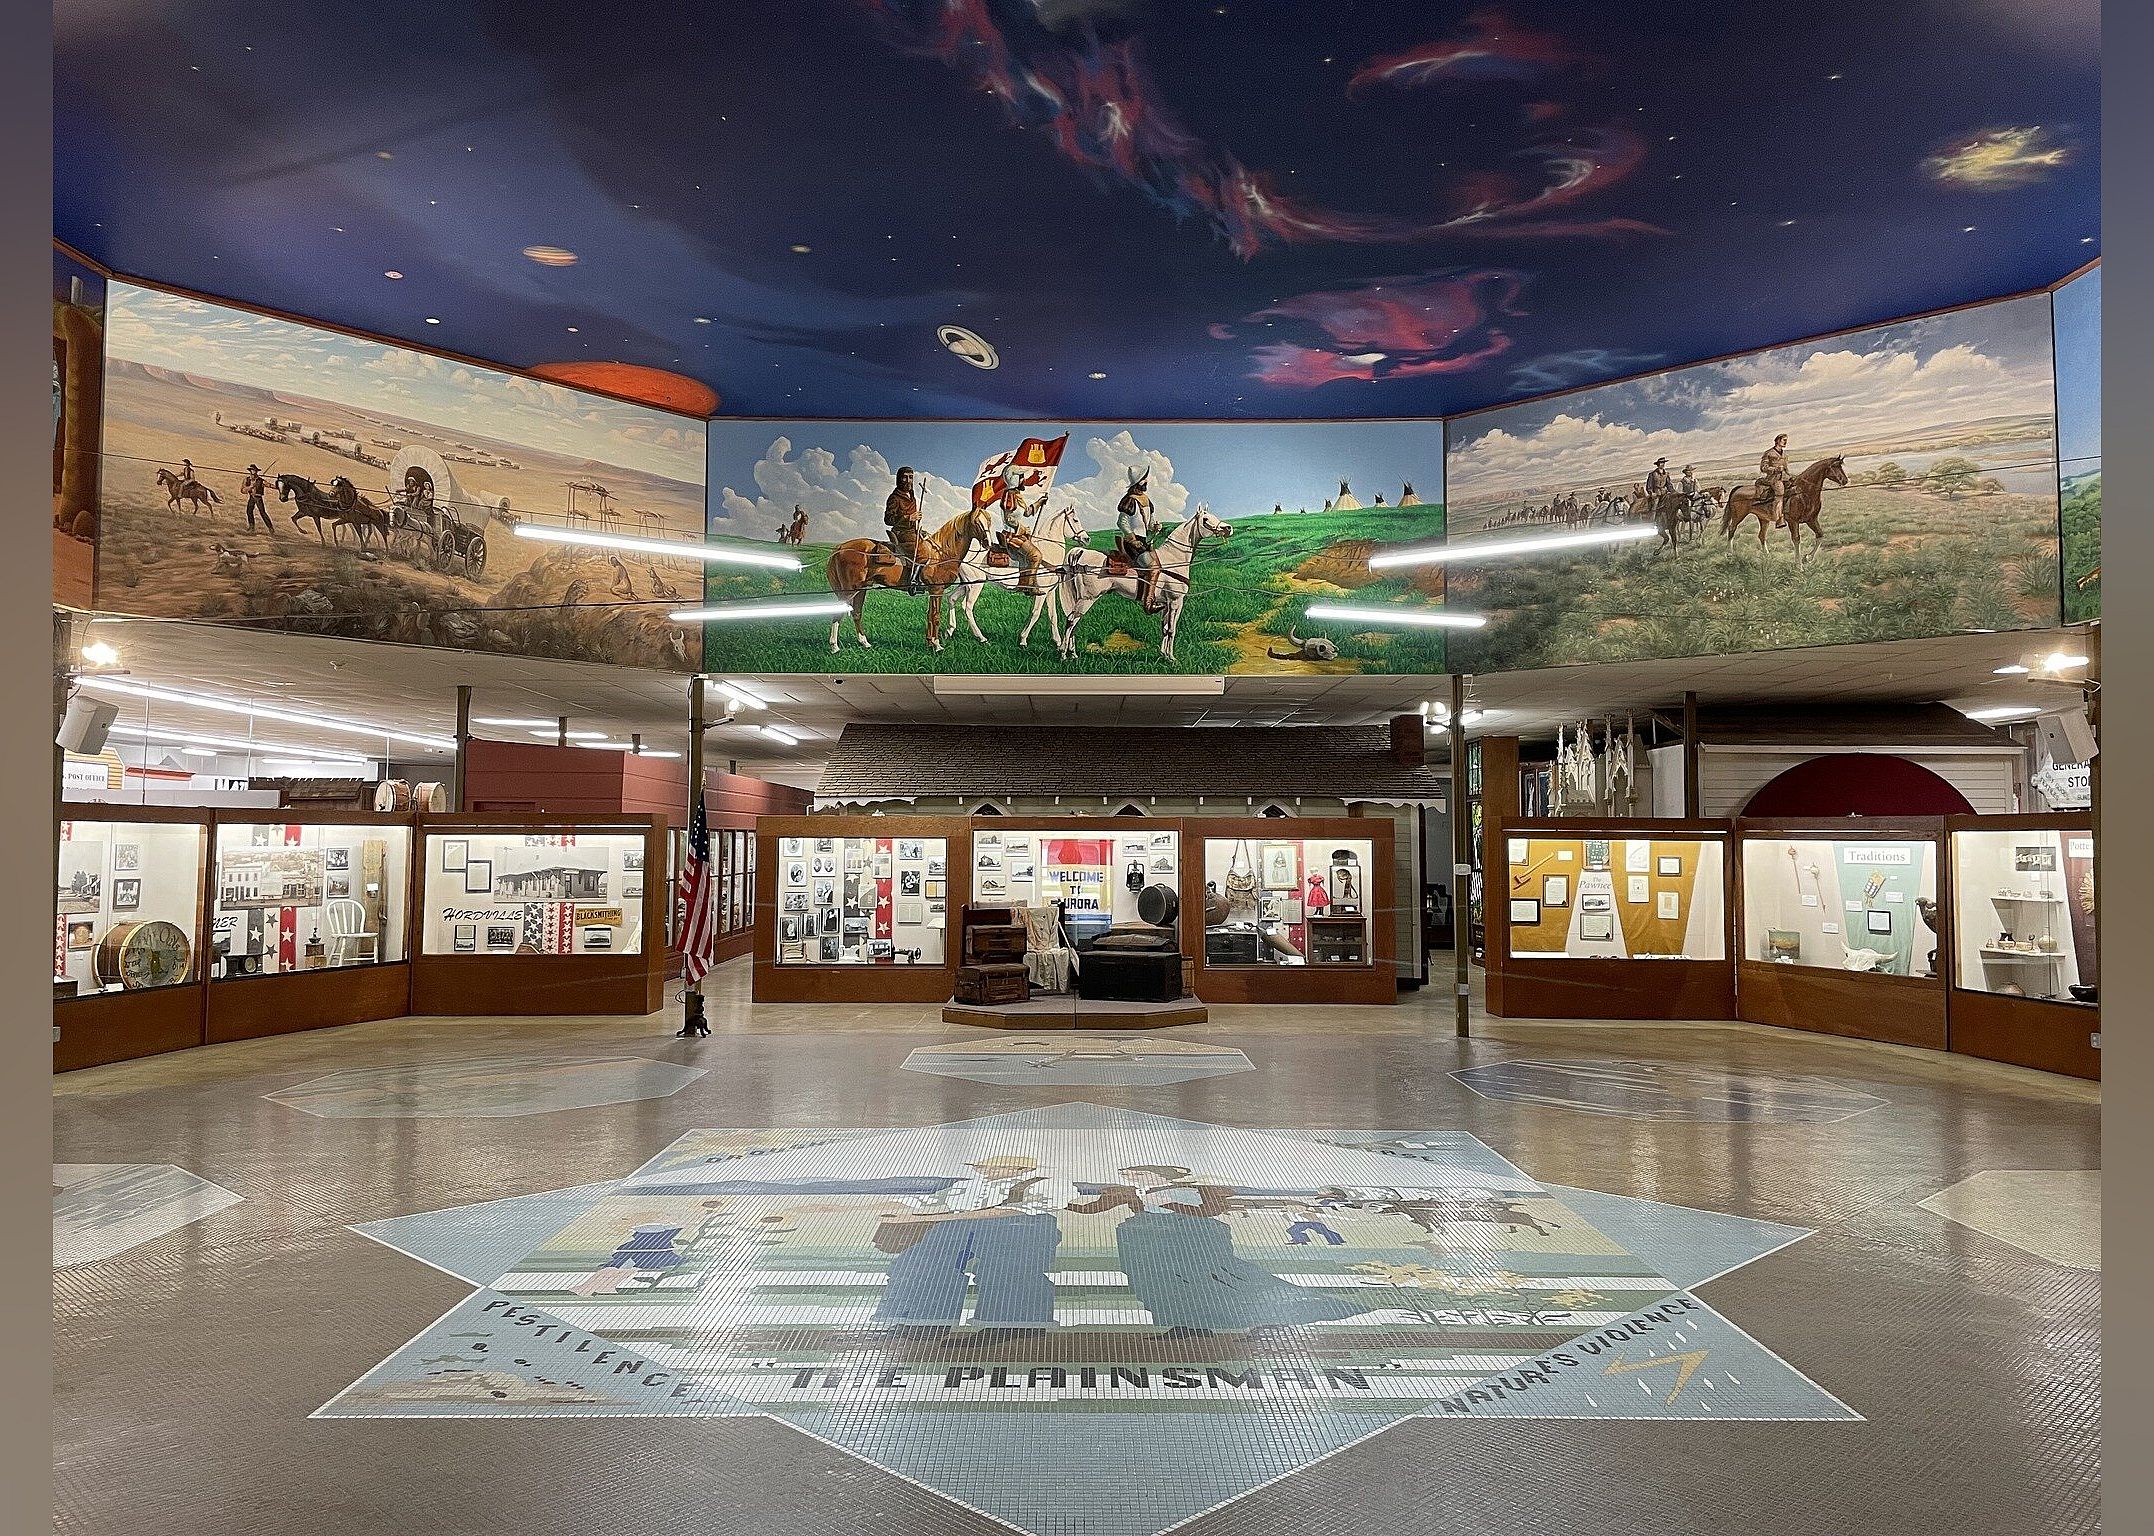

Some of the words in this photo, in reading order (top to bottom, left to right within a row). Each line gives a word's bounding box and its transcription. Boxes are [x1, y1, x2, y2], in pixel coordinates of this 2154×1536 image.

[2068, 776, 2090, 788] STO
[1848, 850, 1906, 861] Traditions
[1050, 871, 1104, 882] WELCOME
[1579, 880, 1612, 889] Pawnee
[1060, 898, 1099, 910] URORA
[443, 907, 524, 921] HORDVILLE
[1576, 1298, 1700, 1355] VIOLENCE
[482, 1300, 695, 1398] PESTILENCE
